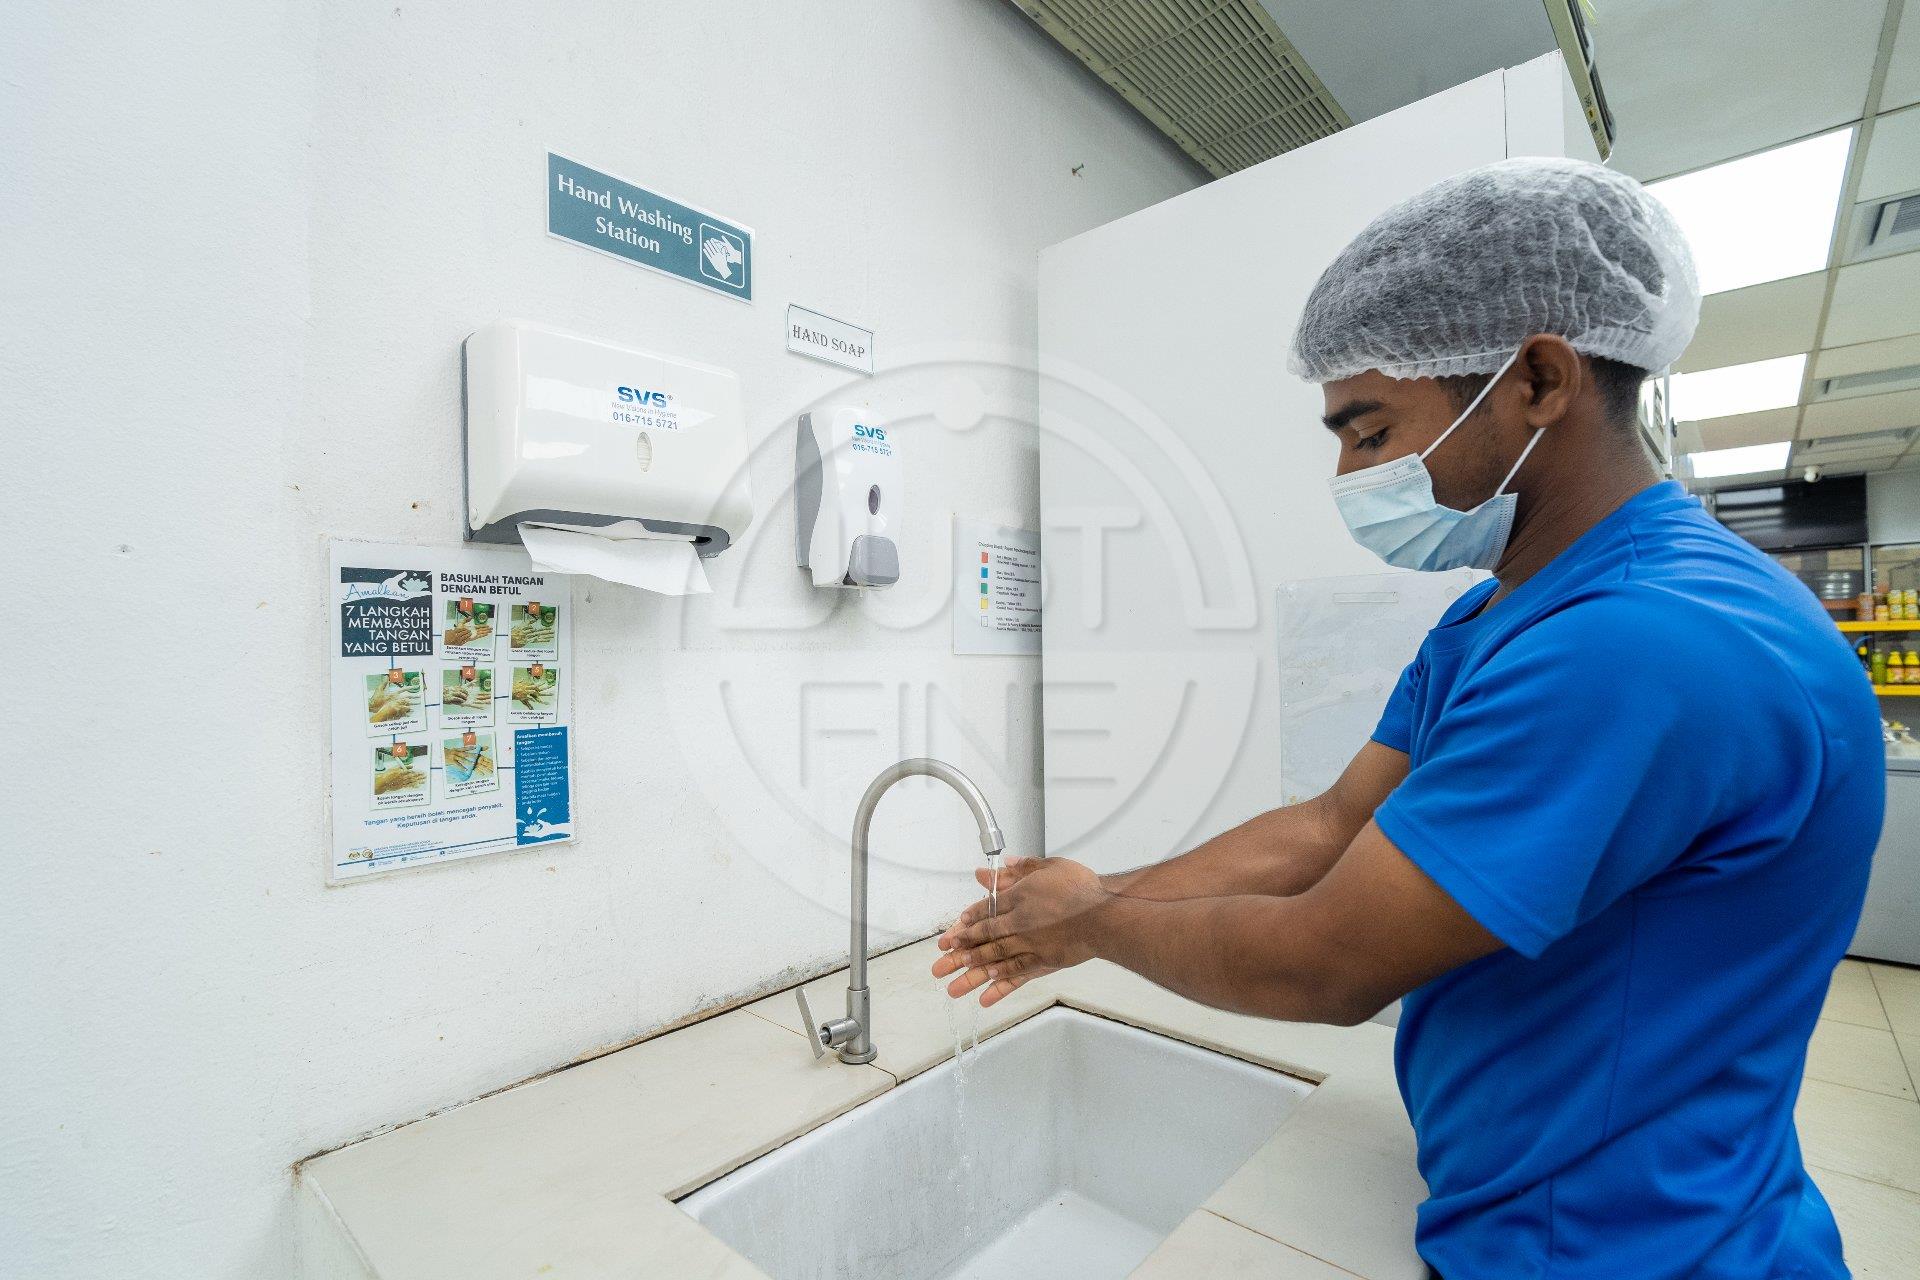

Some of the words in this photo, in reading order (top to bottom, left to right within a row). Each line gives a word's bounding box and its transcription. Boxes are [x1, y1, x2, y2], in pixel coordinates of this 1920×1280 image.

[558, 174, 611, 210] Hand
[618, 196, 693, 245] Washing
[596, 216, 660, 254] Station
[793, 324, 828, 347] HAND
[831, 338, 865, 357] SOAP
[613, 411, 653, 426] 016-715
[656, 419, 678, 430] 5721
[440, 573, 499, 584] BASUHLAH
[502, 576, 544, 586] TANGAN
[441, 584, 487, 594] DENGAN
[490, 586, 522, 595] BETUL
[346, 606, 355, 617] 7
[360, 606, 430, 617] LANGKAH
[348, 618, 430, 629] MEMBASUH
[369, 630, 430, 641] TANGAN
[344, 643, 387, 653] YANG
[392, 642, 431, 653] BETUL
[390, 816, 406, 824] yang
[446, 806, 477, 816] mencegah
[397, 819, 431, 829] Keputusan
[439, 815, 460, 824] tangan
